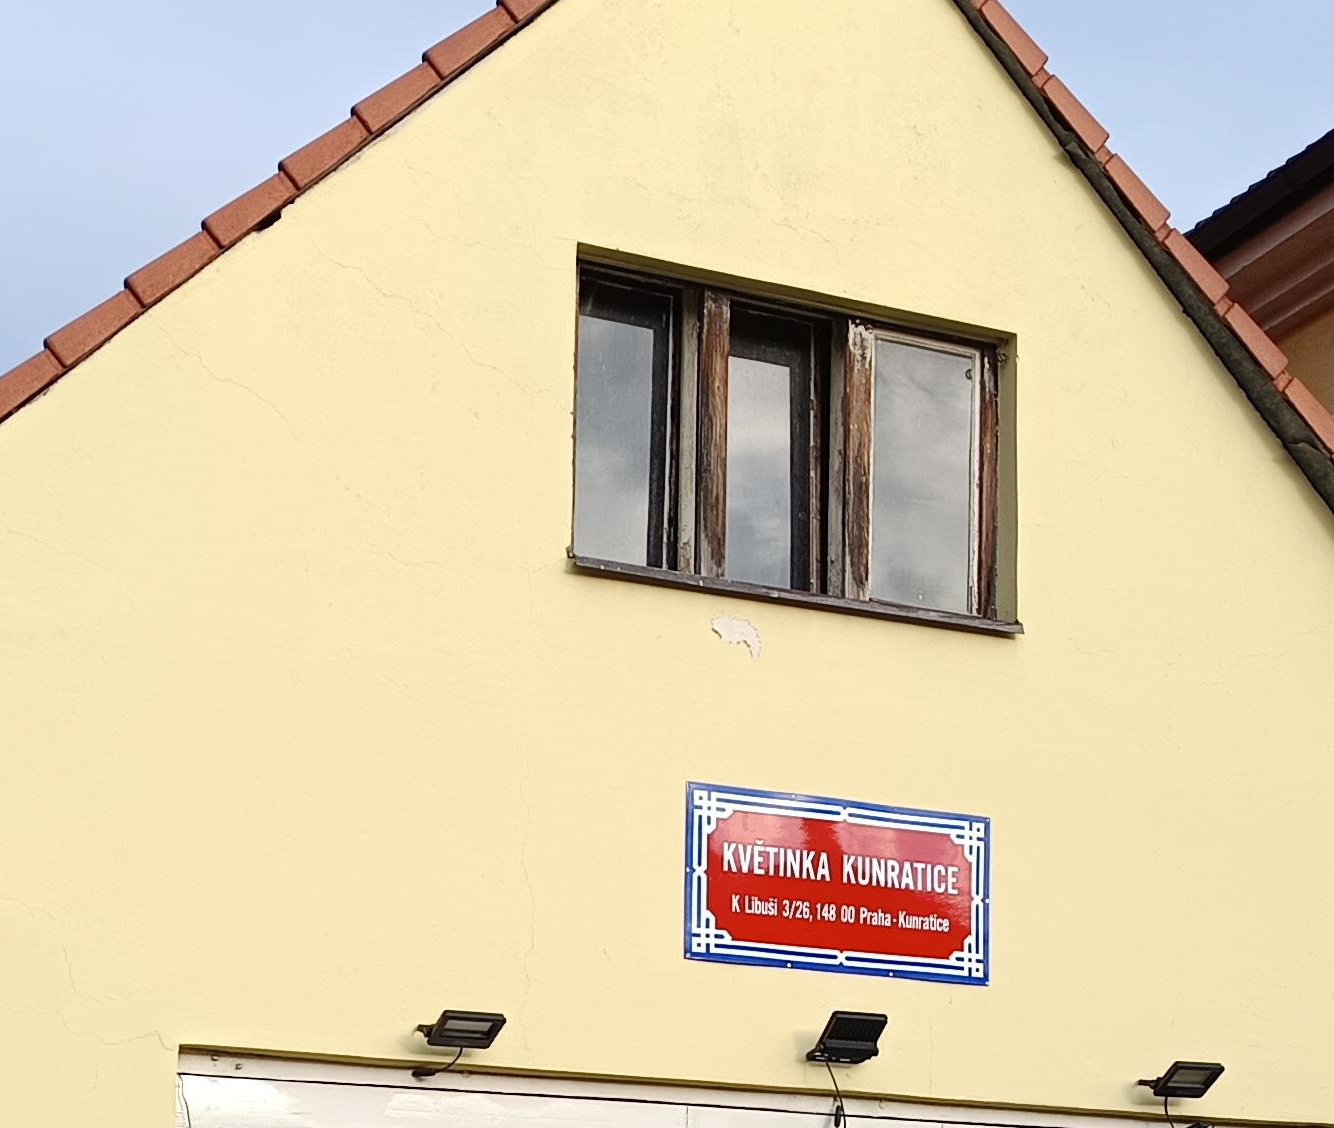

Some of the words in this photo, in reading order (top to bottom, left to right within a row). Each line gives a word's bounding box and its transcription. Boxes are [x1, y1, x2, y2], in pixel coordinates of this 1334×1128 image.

[722, 839, 831, 882] KVĚTINKA
[842, 854, 960, 895] KUNRATICE
[731, 894, 740, 912] K
[745, 895, 778, 916] Libuši
[782, 899, 813, 922] 3/26,
[816, 903, 836, 922] 148
[840, 906, 855, 924] 00
